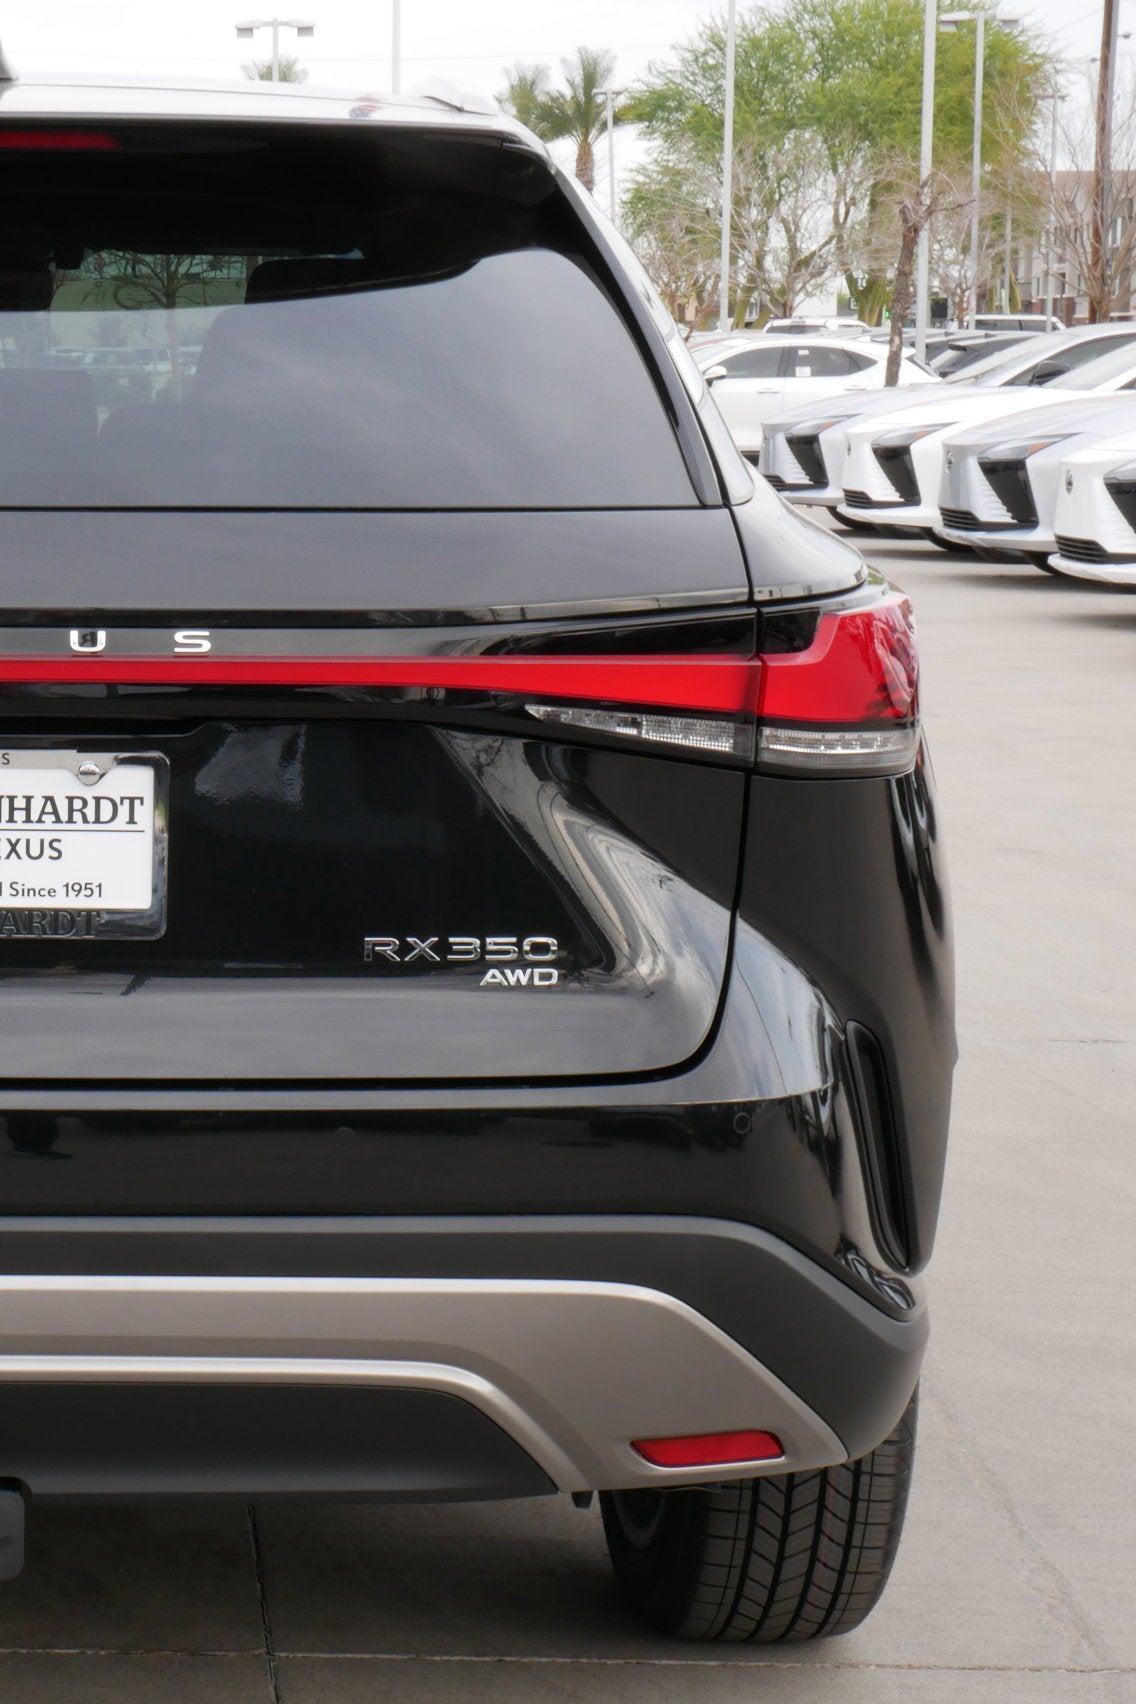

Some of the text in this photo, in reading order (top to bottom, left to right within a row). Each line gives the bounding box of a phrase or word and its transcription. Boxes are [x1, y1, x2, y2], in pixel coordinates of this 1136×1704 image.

[9, 881, 57, 898] Since
[62, 882, 103, 898] 1951
[480, 968, 558, 986] AWD
